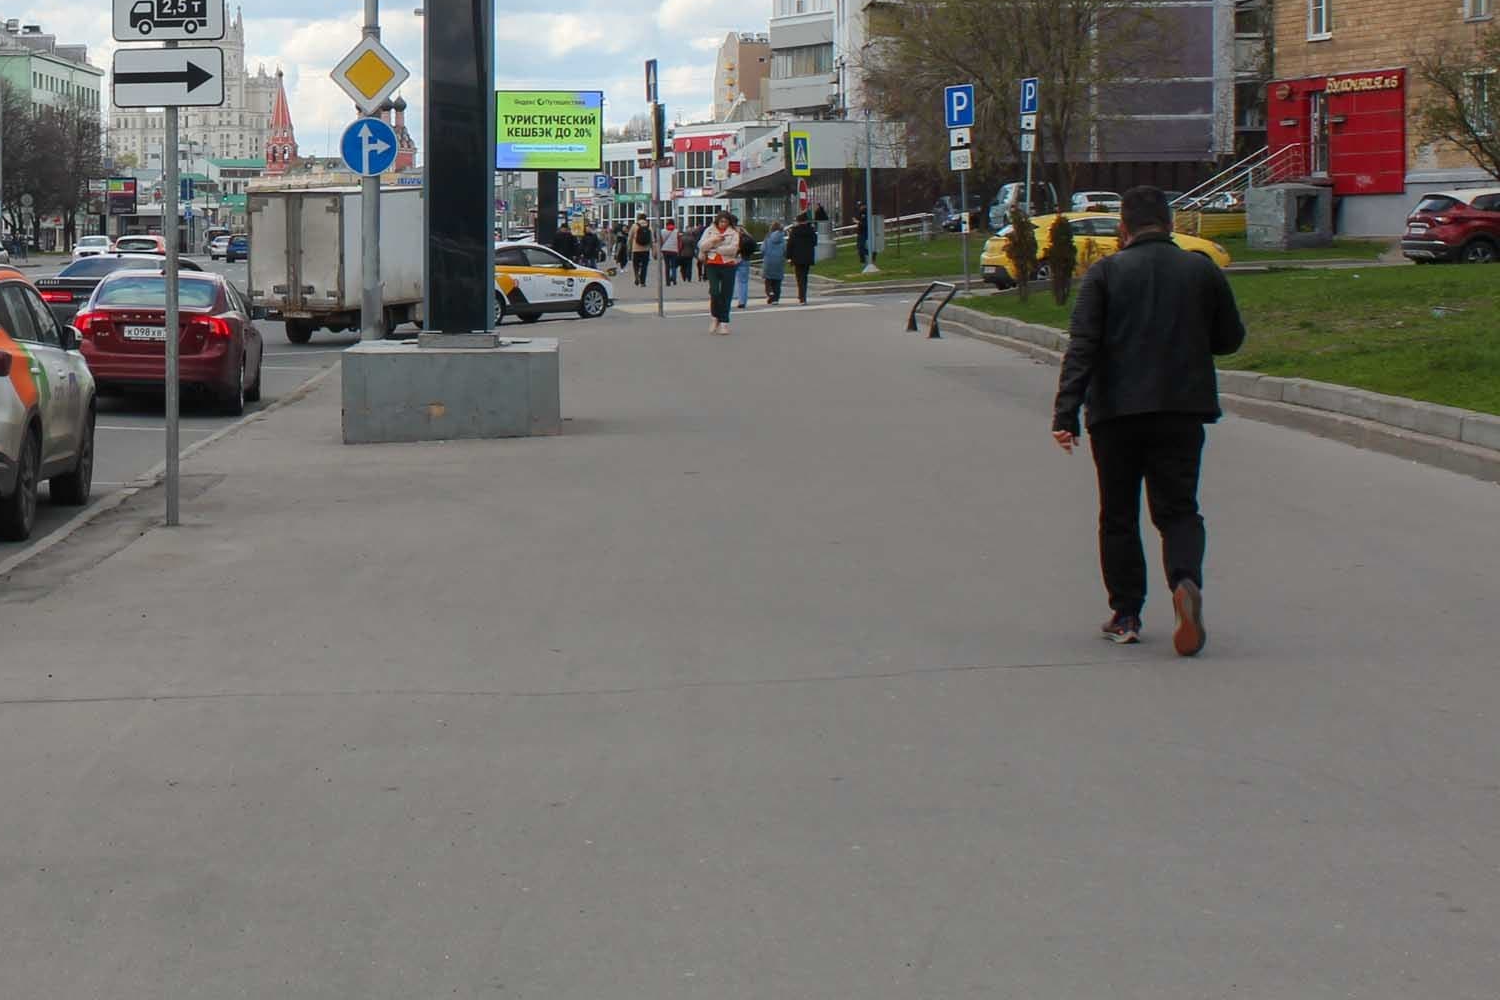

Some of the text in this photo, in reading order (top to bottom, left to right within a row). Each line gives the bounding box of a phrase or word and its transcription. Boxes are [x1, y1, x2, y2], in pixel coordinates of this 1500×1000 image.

[1025, 82, 1035, 109] P
[952, 91, 968, 122] P
[503, 113, 596, 125] ТУРИСТИЧЕСКИЙ
[507, 127, 592, 139] КЕШБЭК ДО 20%
[596, 176, 606, 188] P
